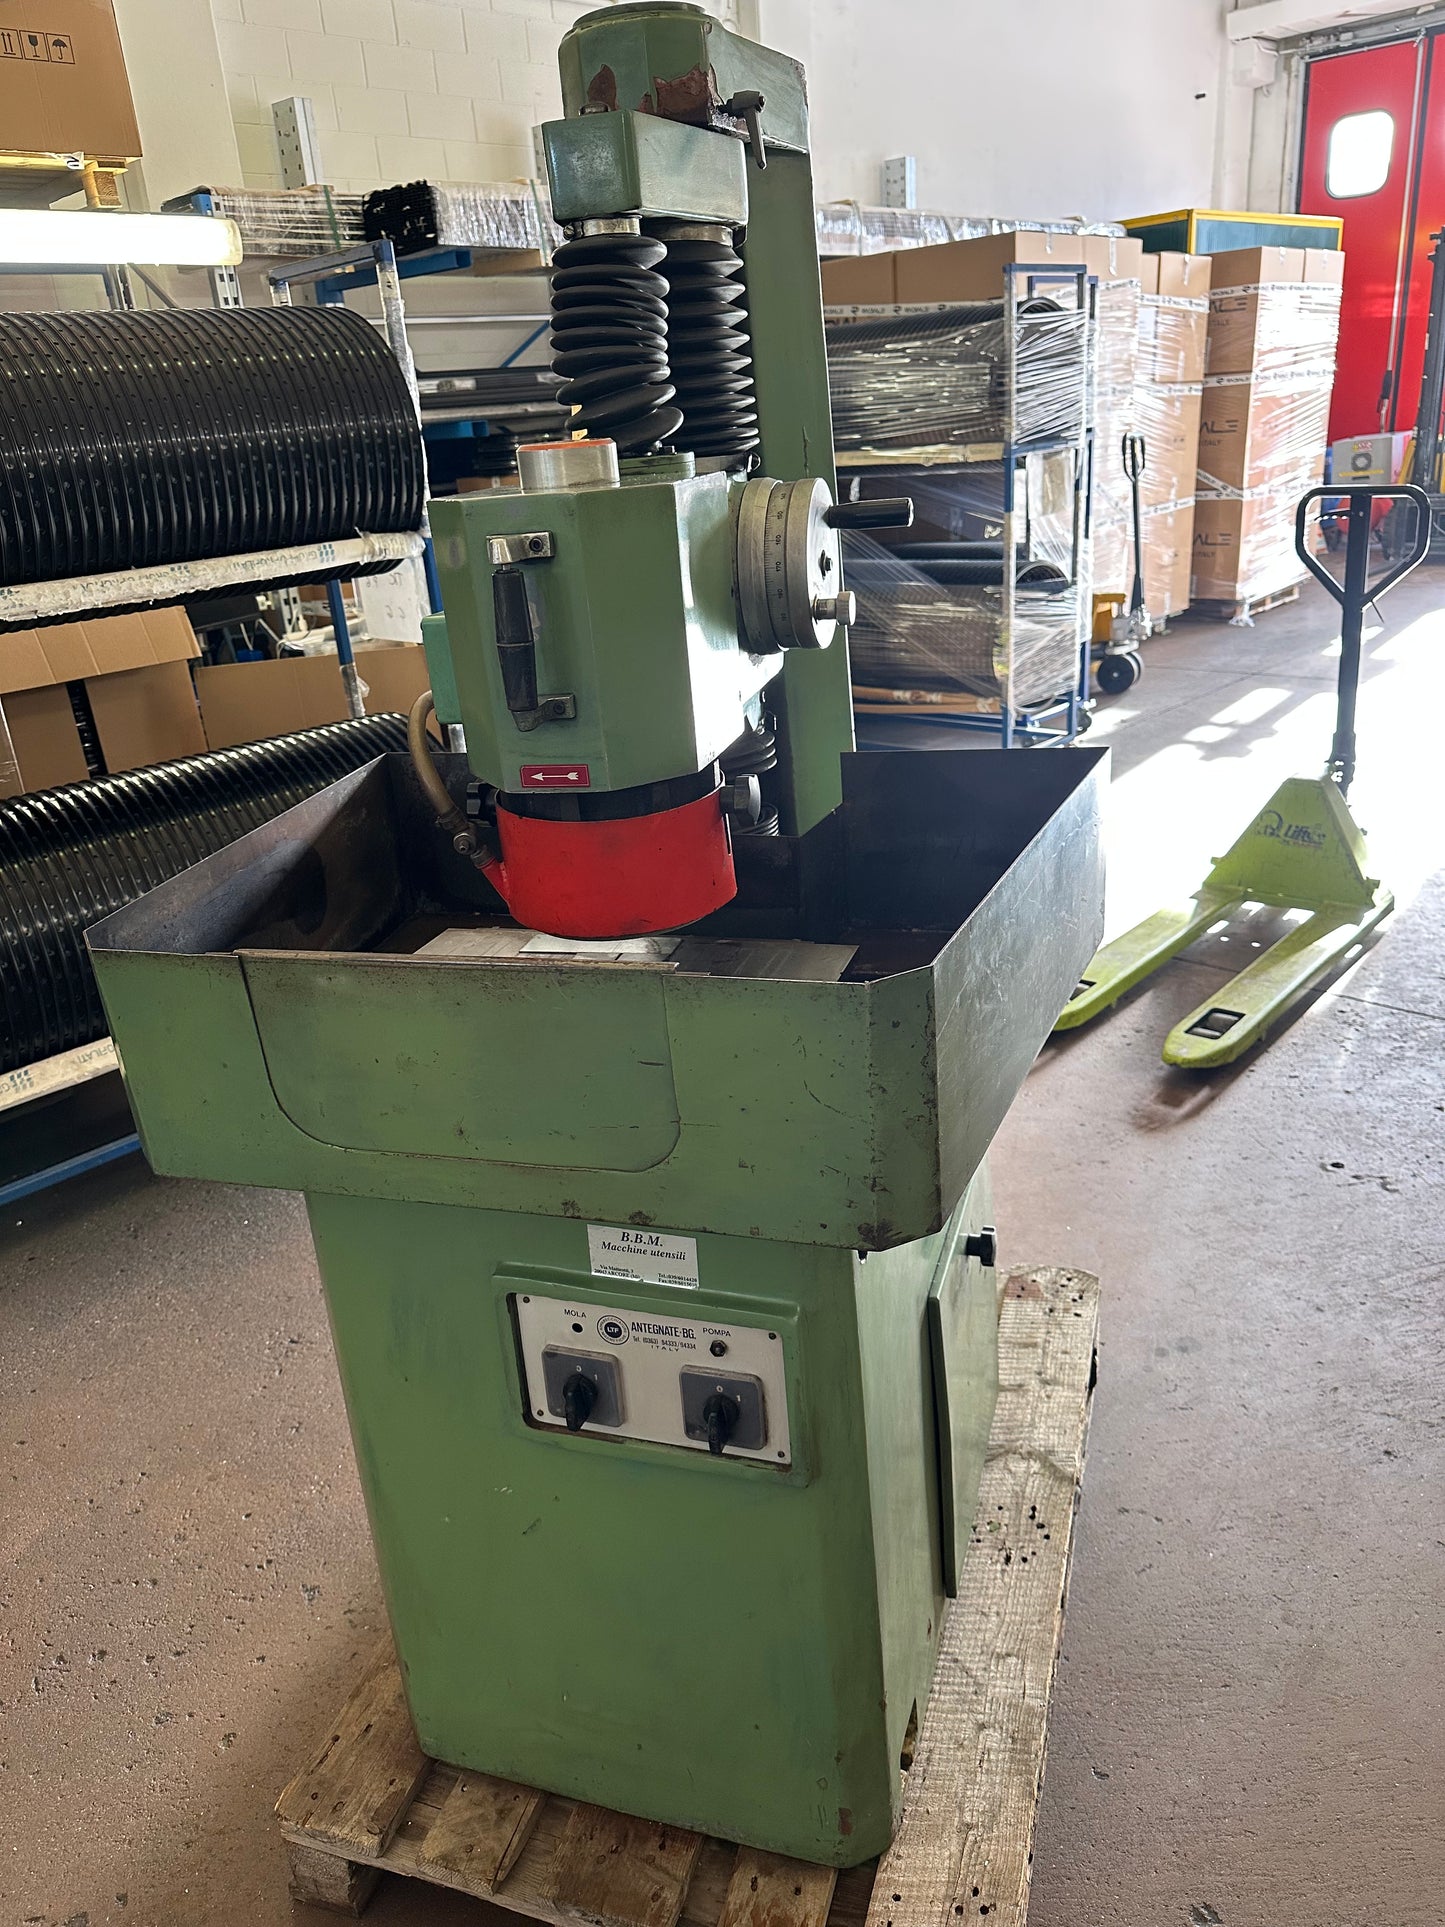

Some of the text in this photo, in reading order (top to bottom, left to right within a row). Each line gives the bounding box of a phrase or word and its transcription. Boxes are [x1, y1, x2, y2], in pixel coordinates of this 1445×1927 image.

[621, 1231, 663, 1247] B.B.M.
[601, 1241, 686, 1260] Macchine utensili
[564, 1308, 587, 1319] MOLA
[606, 1326, 620, 1334] LTF
[702, 1327, 732, 1337] POMPA
[632, 1335, 641, 1343] Tel.
[716, 1385, 724, 1393] 0
